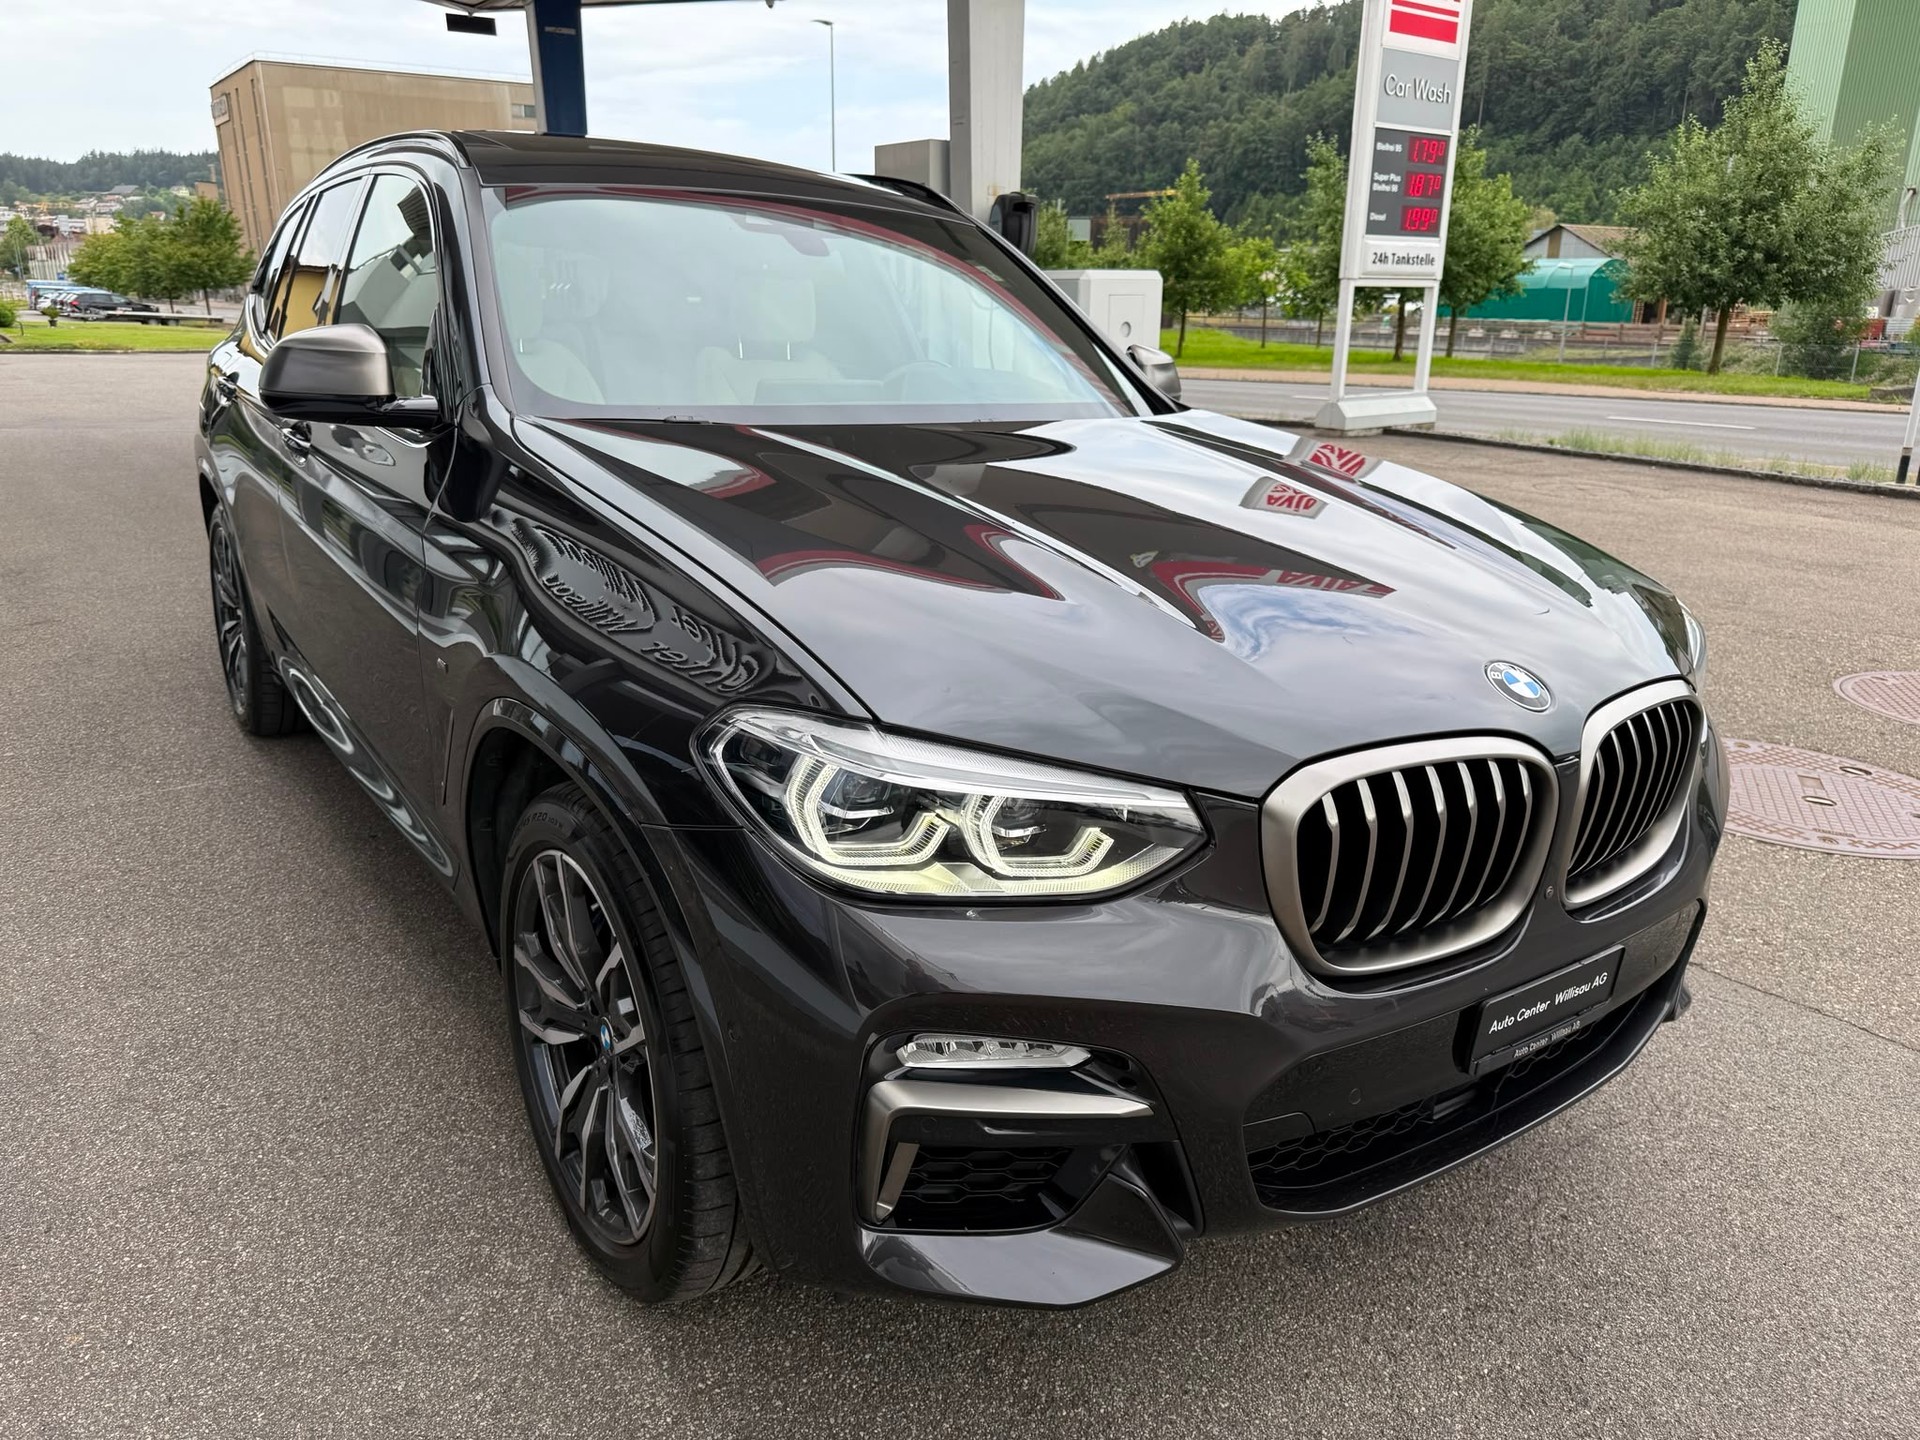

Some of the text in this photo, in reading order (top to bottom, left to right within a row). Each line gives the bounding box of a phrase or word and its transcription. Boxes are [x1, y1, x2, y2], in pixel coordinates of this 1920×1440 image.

[1384, 73, 1452, 104] Car Wash
[1373, 172, 1402, 183] Super Plus
[1369, 212, 1387, 222] Diesel
[1372, 252, 1436, 266] 24h Tankstelle
[1488, 972, 1608, 1034] Auto Center Willisau AG
[1513, 1044, 1528, 1058] Auto
[1529, 1037, 1548, 1053] Center
[1550, 1027, 1572, 1041] Willisau
